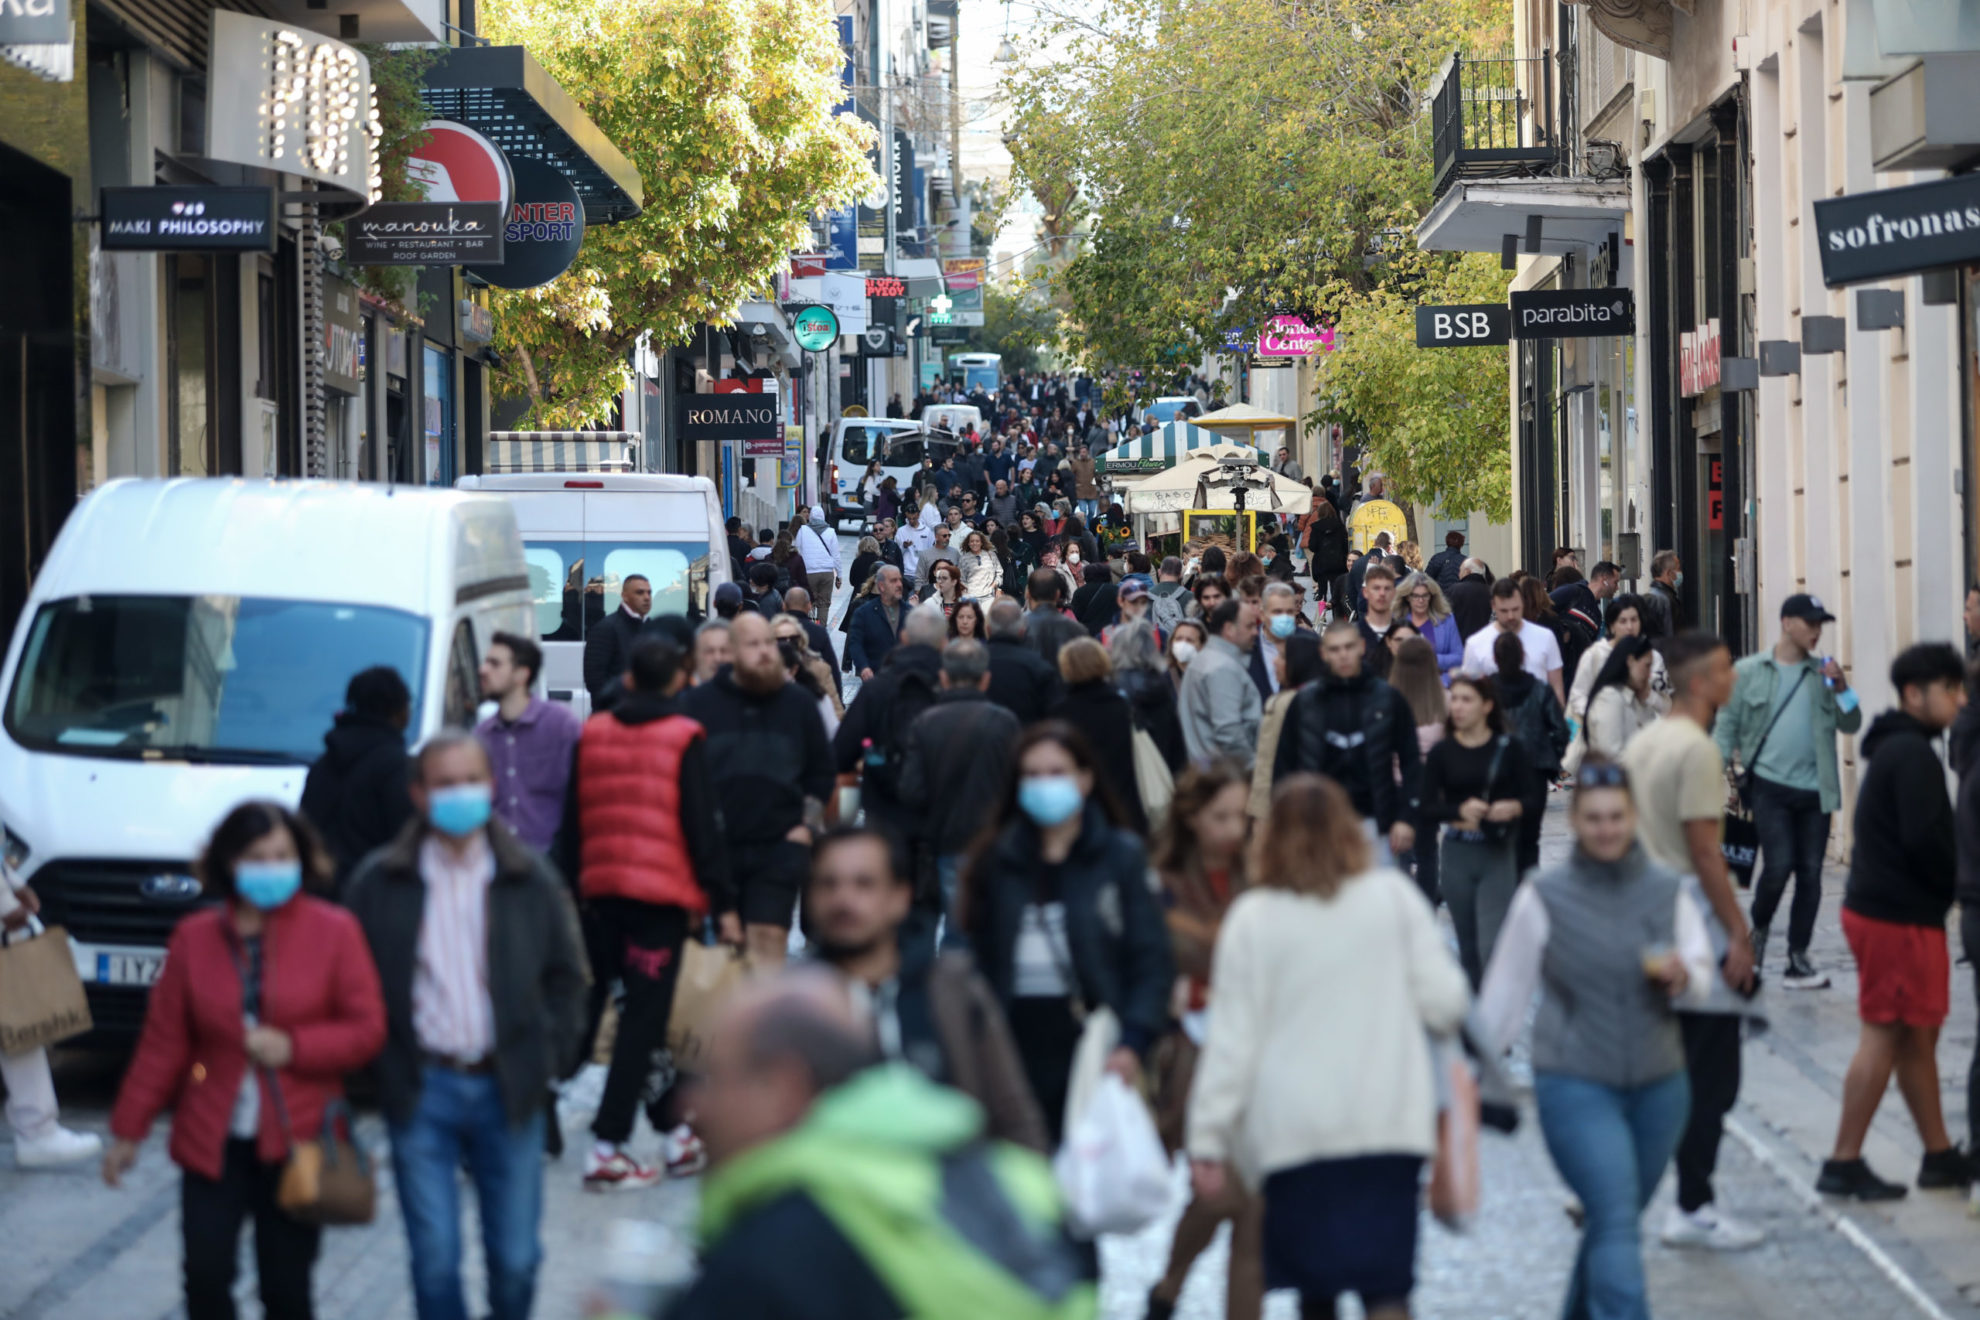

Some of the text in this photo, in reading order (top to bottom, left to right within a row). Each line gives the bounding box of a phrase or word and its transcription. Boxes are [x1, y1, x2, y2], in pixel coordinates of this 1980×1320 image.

[109, 219, 265, 235] MAKI PHILOSOPHY
[363, 207, 485, 235] manouka
[1828, 207, 1980, 251] sofronas
[505, 222, 574, 242] SPORT
[366, 240, 484, 249] WINE RESTAURANT BAR
[393, 252, 417, 260] ROOF
[1523, 303, 1611, 327] parabita
[1434, 312, 1491, 340] BSB
[688, 409, 772, 424] ROMANO
